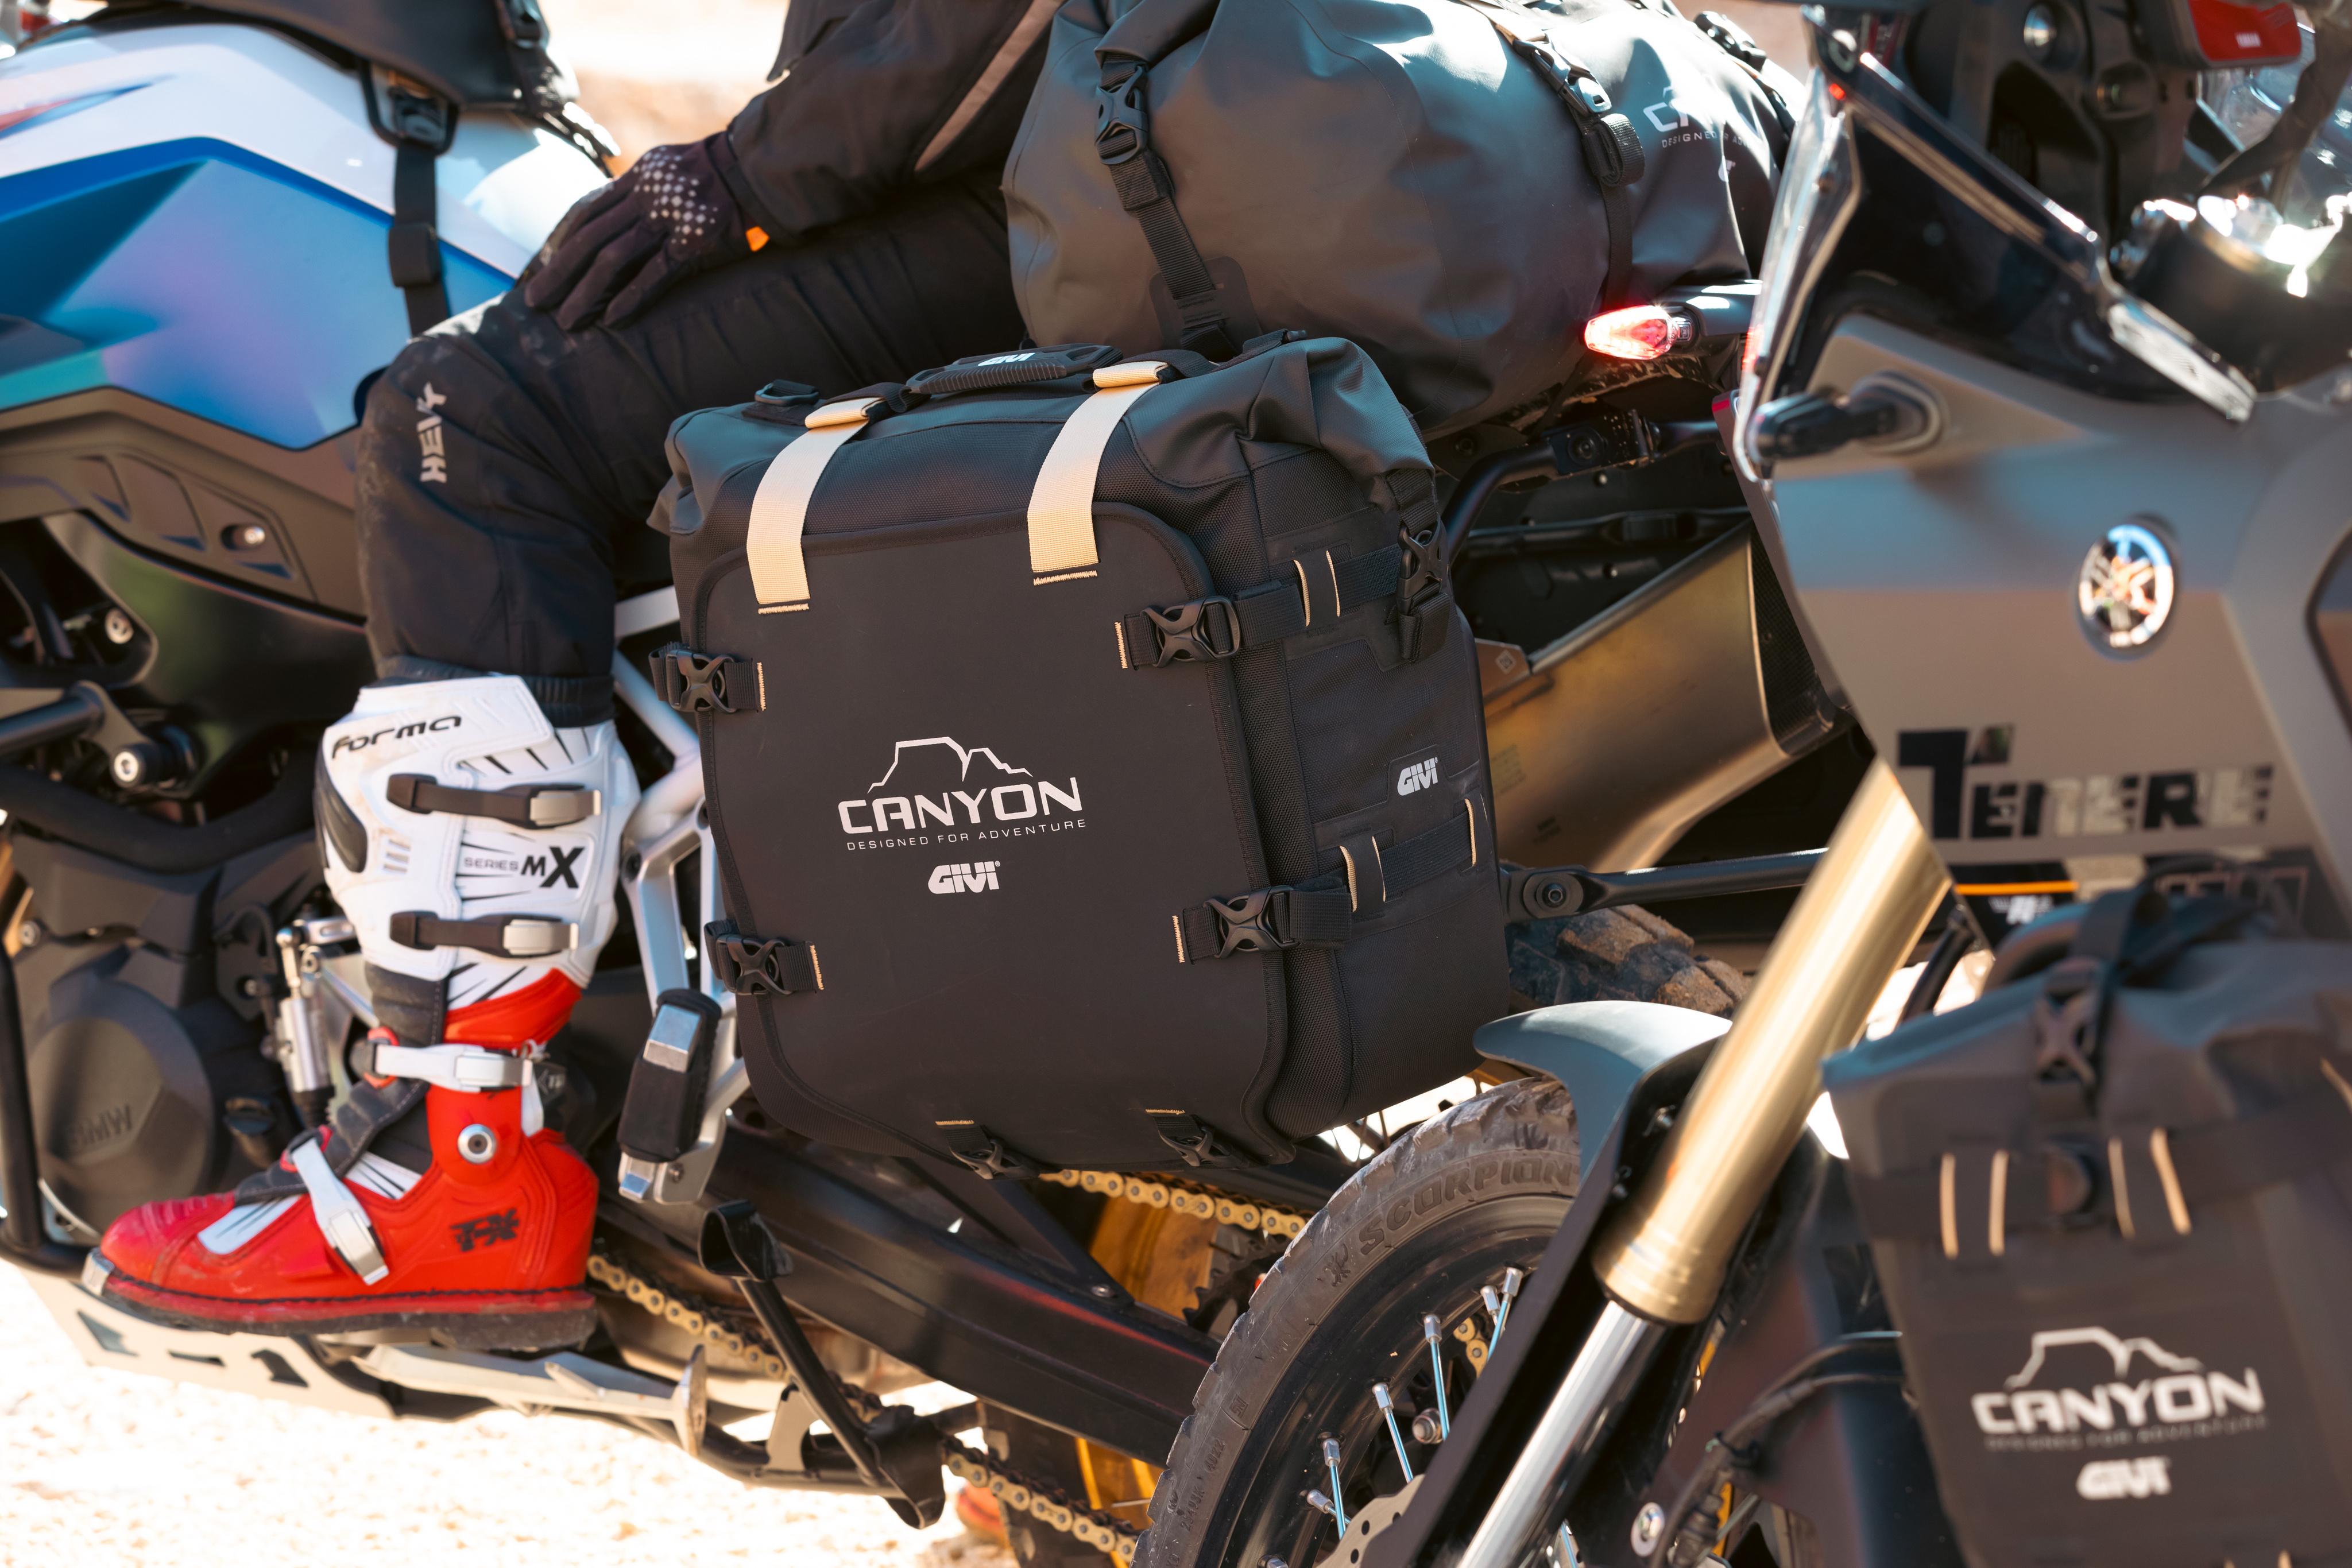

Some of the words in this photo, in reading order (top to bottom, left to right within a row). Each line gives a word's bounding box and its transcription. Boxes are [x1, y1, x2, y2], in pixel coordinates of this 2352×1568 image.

[838, 777, 1082, 834] CANYON
[847, 836, 929, 850] DESIGNED
[938, 833, 969, 843] FOR
[978, 819, 1086, 840] ADVENTURE
[464, 857, 519, 872] SERIES
[520, 846, 585, 889] MX
[1359, 1157, 1572, 1256] SCORPION
[1971, 1366, 2265, 1434] CANYON
